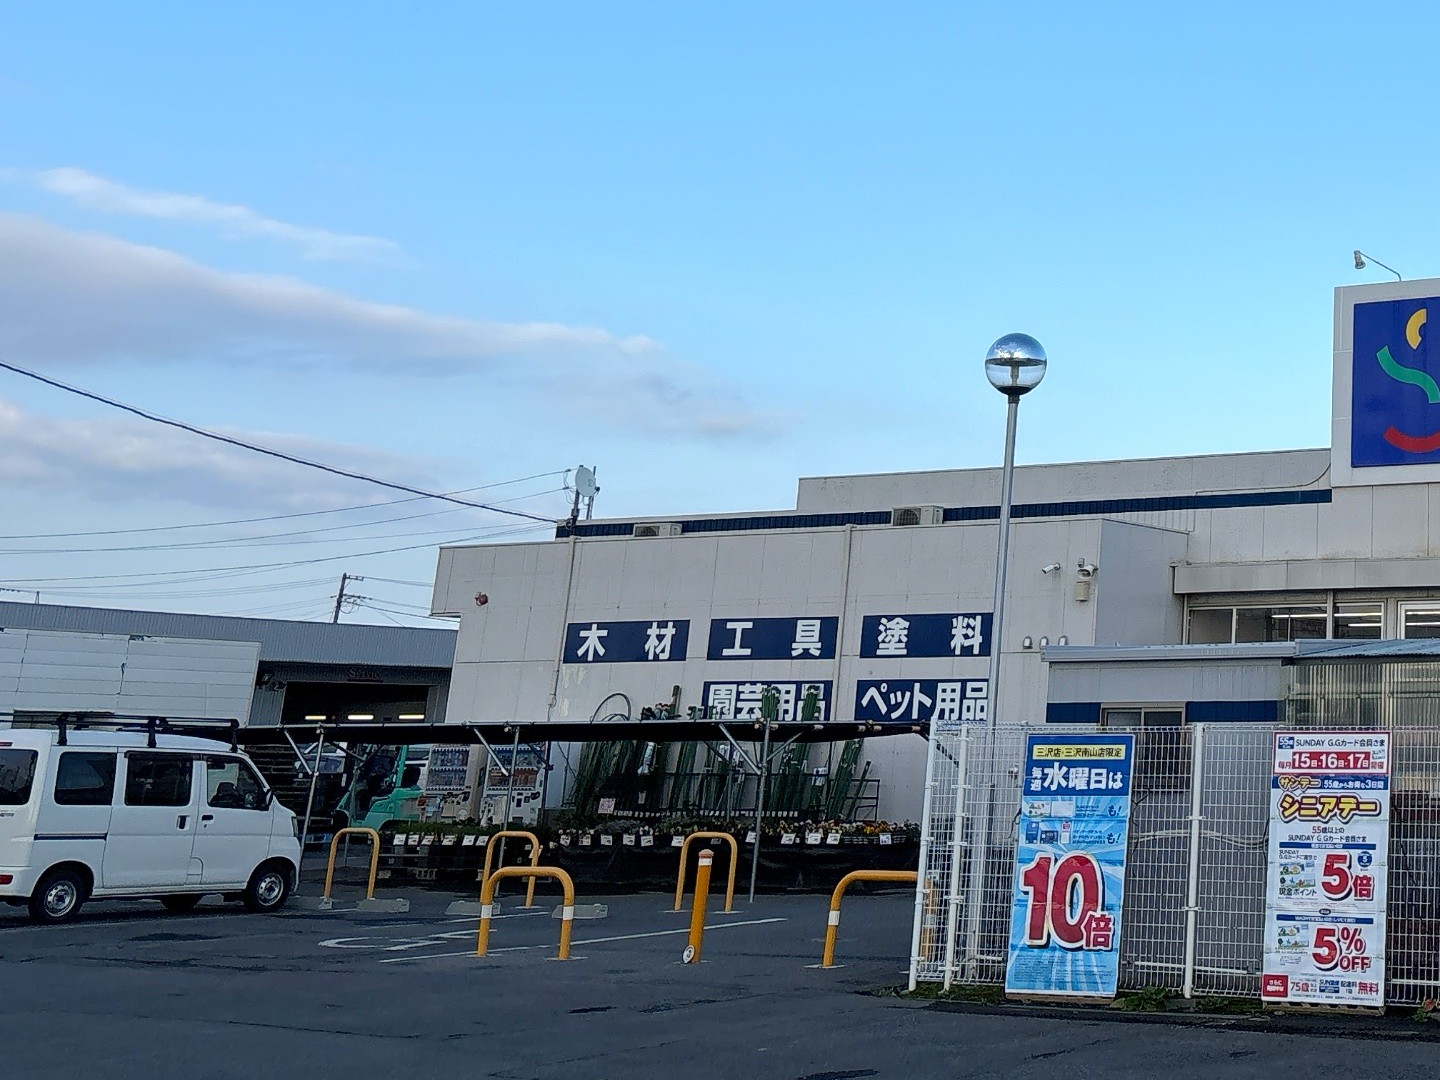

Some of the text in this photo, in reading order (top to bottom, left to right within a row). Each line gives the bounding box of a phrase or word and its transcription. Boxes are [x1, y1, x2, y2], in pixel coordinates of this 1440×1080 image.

[576, 622, 677, 661] 木材
[721, 619, 822, 657] 工具
[876, 615, 983, 656] 塗料
[861, 682, 988, 721] ペット用品
[1295, 739, 1326, 747] SUNDAY
[1287, 834, 1315, 842] SUNDAY
